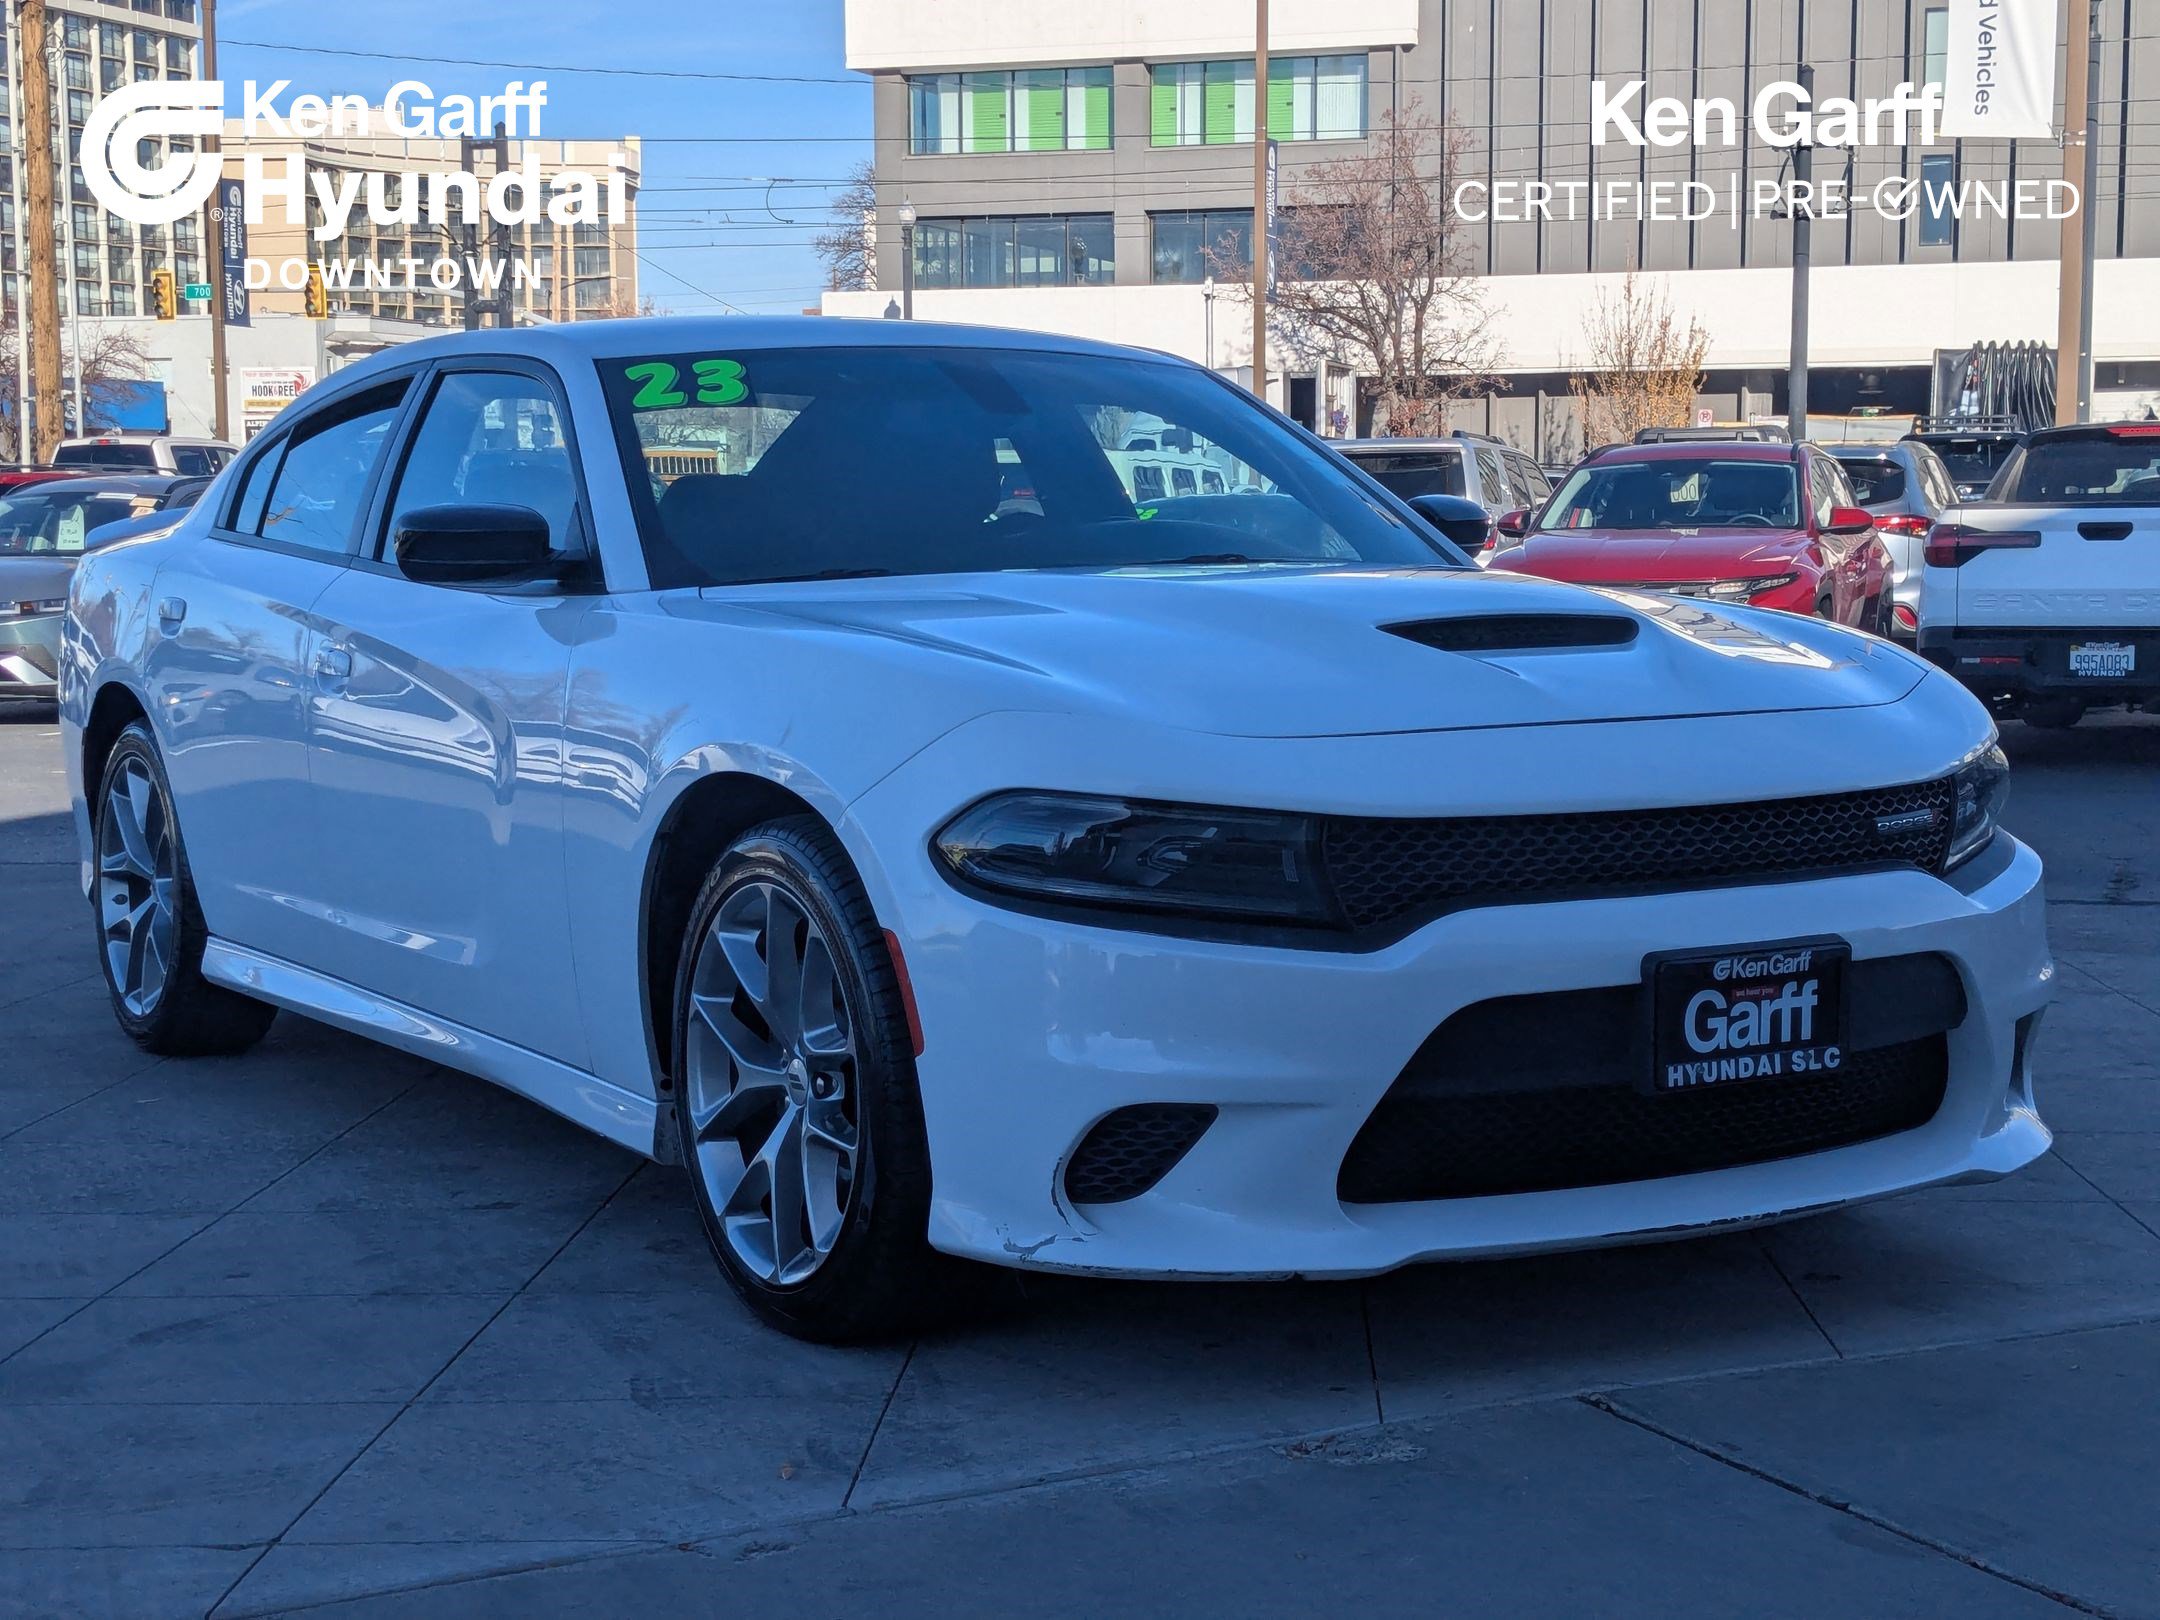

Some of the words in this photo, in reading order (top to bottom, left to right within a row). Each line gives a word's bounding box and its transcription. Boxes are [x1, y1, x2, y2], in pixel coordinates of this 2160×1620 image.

[1974, 14, 1999, 116] Vehicles
[229, 206, 239, 259] Hyundai
[194, 286, 211, 297] 700
[624, 359, 750, 408] 23
[1732, 957, 1767, 979] Ken
[1769, 951, 1812, 974] Garff
[1684, 979, 1819, 1054] Garff
[1667, 1052, 1783, 1088] HYUNDAI
[1791, 1047, 1841, 1073] SLC
